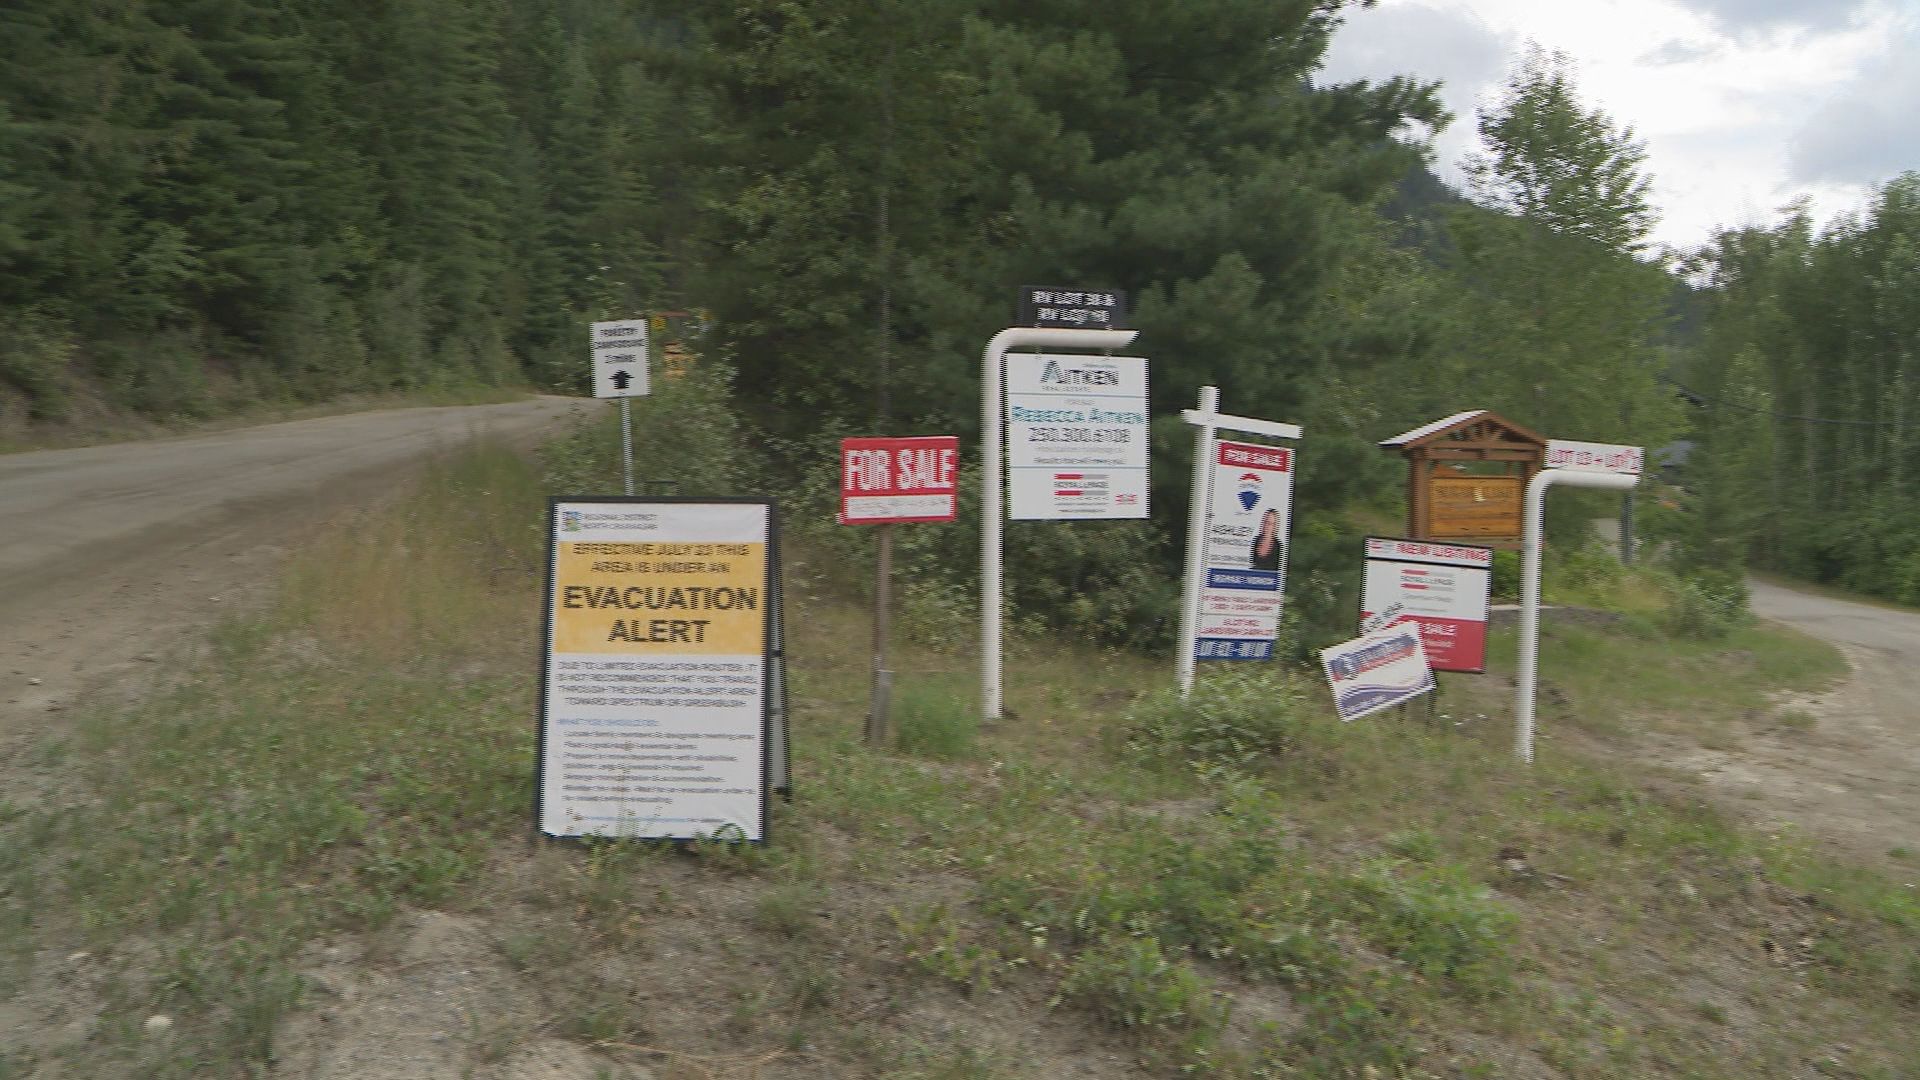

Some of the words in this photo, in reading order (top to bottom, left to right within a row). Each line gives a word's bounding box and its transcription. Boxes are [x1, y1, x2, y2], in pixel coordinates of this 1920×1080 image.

[1033, 291, 1053, 304] RV
[1056, 292, 1084, 305] LOT
[1085, 293, 1102, 306] 38
[1103, 293, 1115, 307] &
[1039, 307, 1059, 321] RV
[1012, 406, 1084, 423] REBECCA
[1089, 408, 1144, 424] AITKEN
[1029, 427, 1130, 443] 250.300.6108
[1225, 449, 1250, 464] FOR
[1251, 452, 1282, 468] SALE
[846, 449, 891, 491] FOR
[898, 448, 954, 490] SALE
[1212, 524, 1253, 538] ASHLEY
[574, 543, 653, 556] EFFECTIVE
[656, 543, 692, 556] JULY
[696, 544, 712, 556] 23
[716, 544, 749, 556] THIS
[1398, 543, 1430, 556] NEW
[1434, 547, 1488, 561] LISTING
[591, 561, 633, 573] AREA
[635, 561, 650, 573] IS
[653, 561, 705, 573] UNDER
[707, 562, 729, 573] AN
[564, 586, 756, 610] EVACUATION
[609, 619, 710, 643] ALERT
[1423, 622, 1457, 637] SALE
